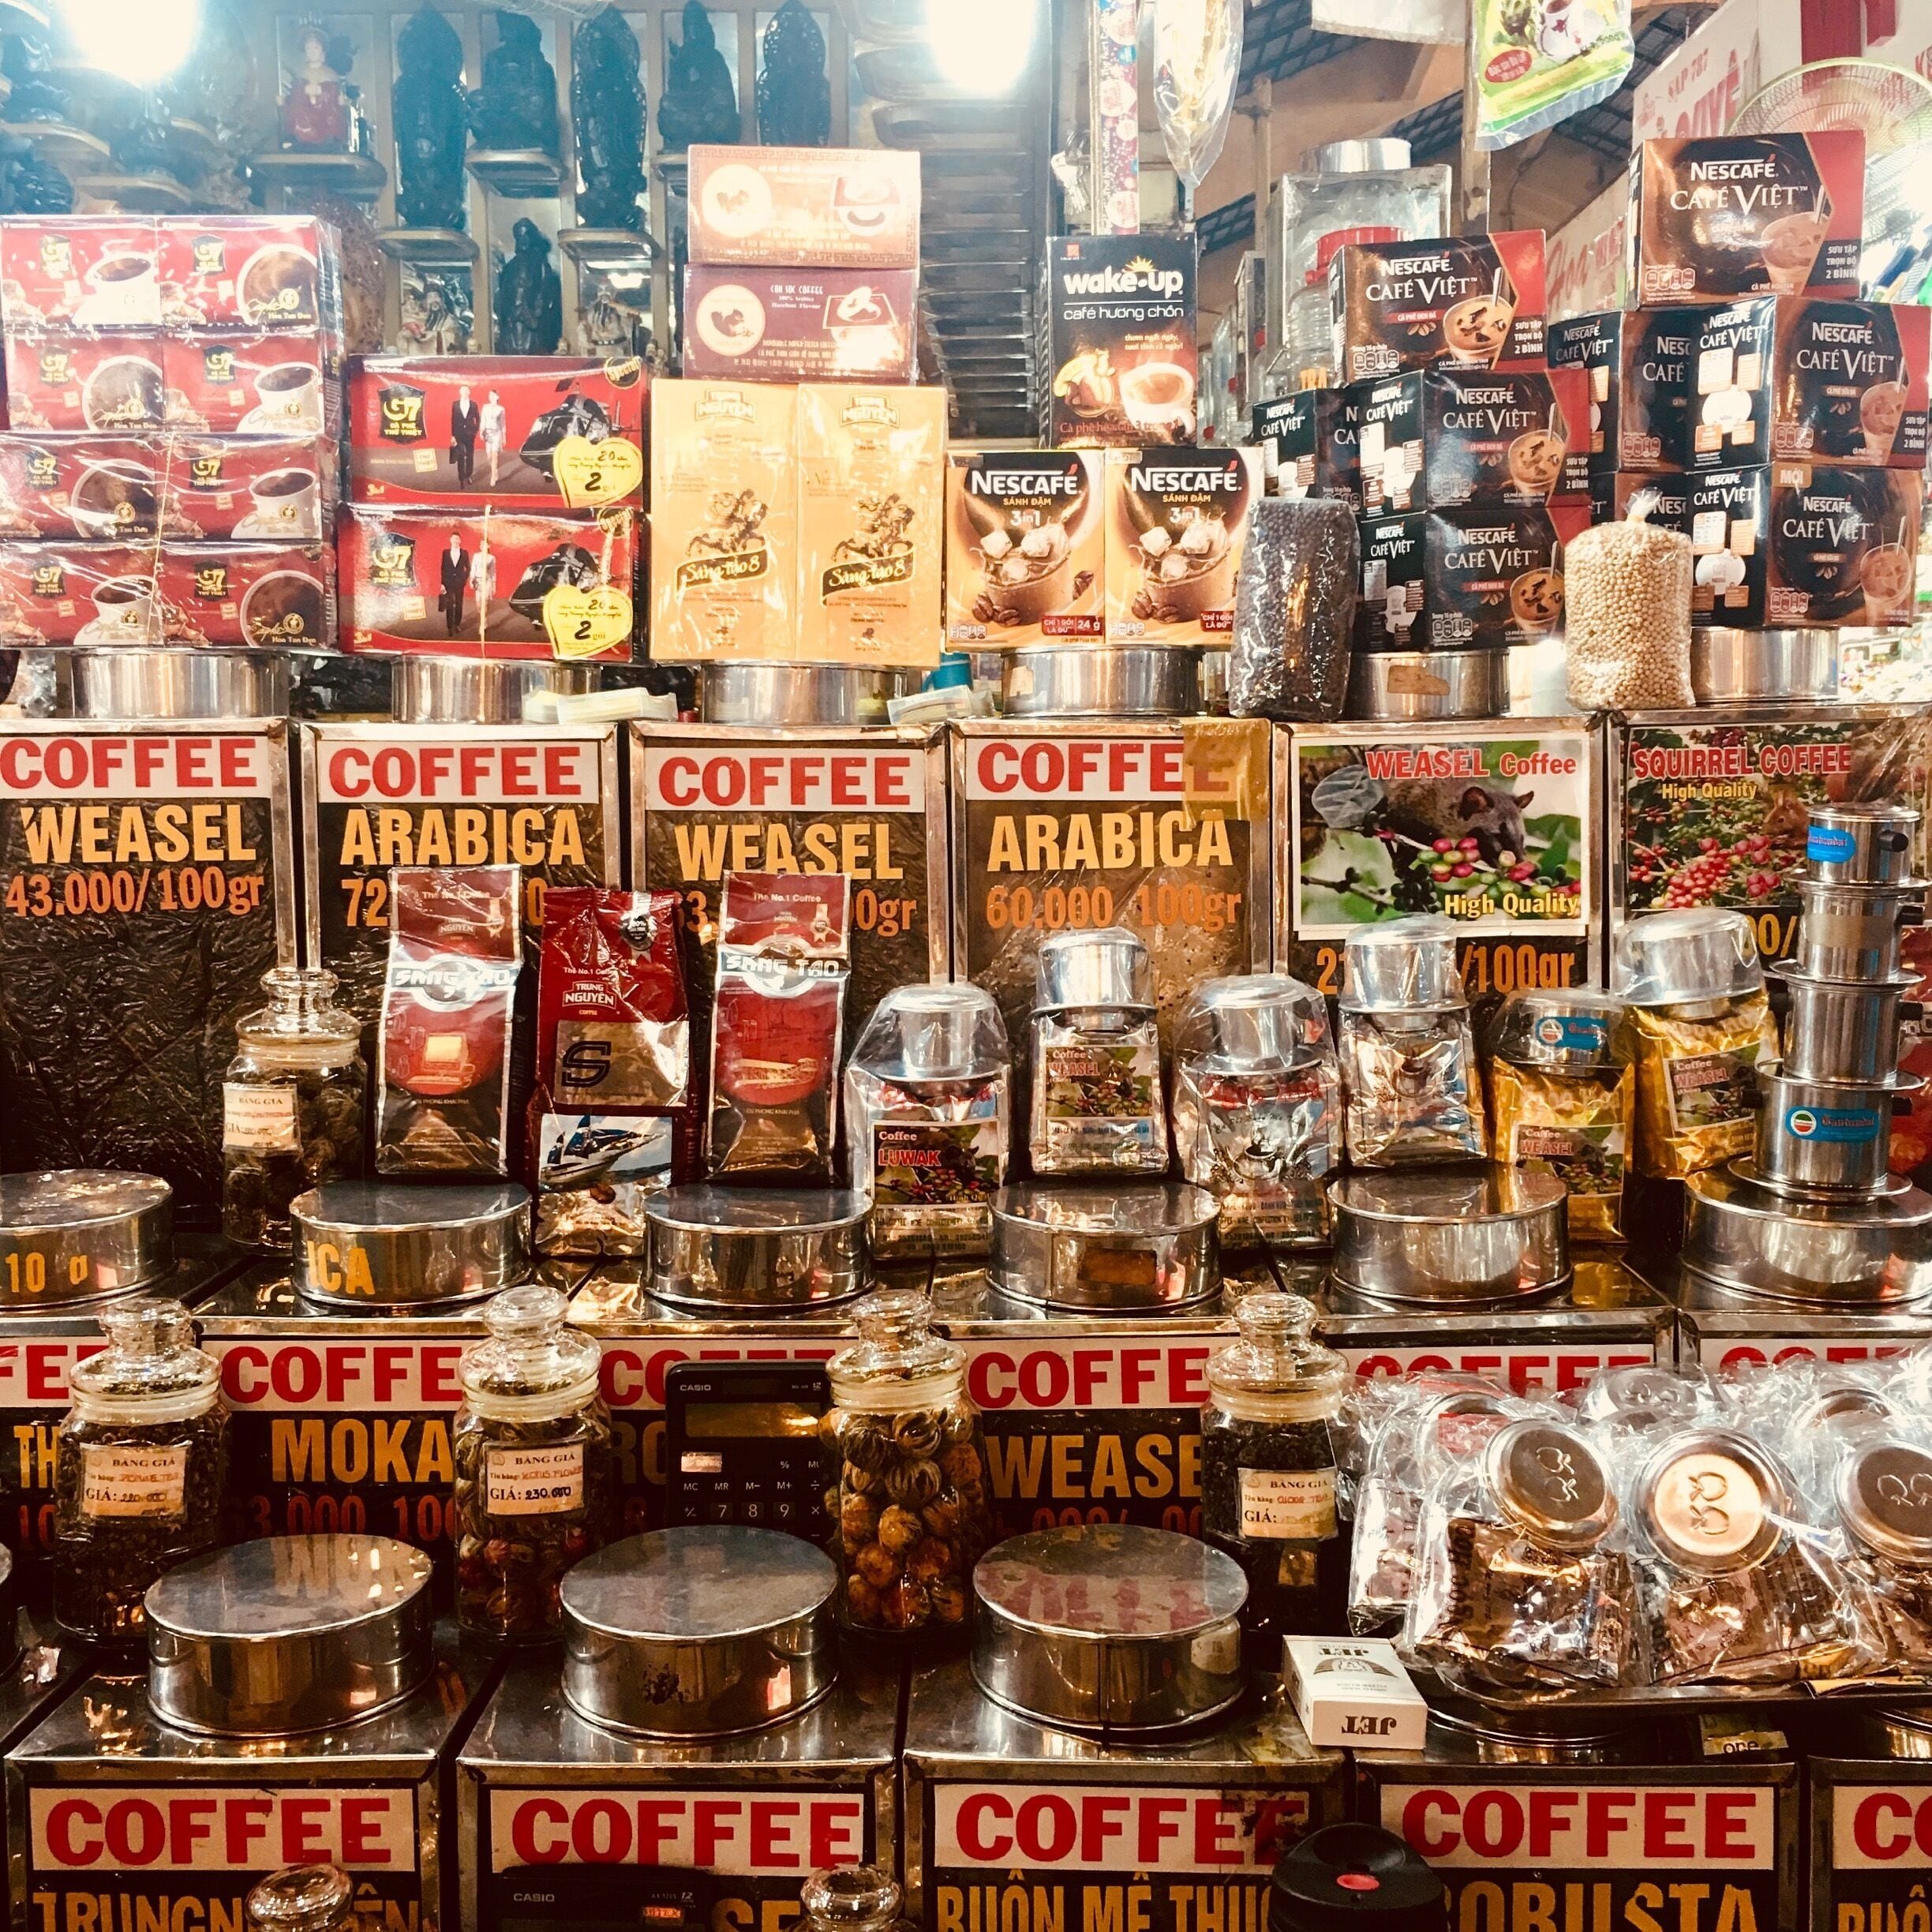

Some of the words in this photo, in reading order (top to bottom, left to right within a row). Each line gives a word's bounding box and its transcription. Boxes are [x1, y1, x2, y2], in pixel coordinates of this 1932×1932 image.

[1381, 251, 1453, 276] NESCAFÉ
[1366, 278, 1414, 302] CAFÉ
[1064, 306, 1096, 320] café
[1563, 320, 1601, 343] NESCAFÉ
[1700, 334, 1728, 349] CAFÉ
[1812, 320, 1874, 345] NESCAFÉ
[1515, 346, 1521, 354] 2
[1642, 362, 1685, 383] CAFÉ
[1796, 349, 1840, 371] CAFÉ
[1840, 349, 1887, 380] VIỆT
[1456, 384, 1516, 405] NESCAFÉ
[384, 397, 421, 421] G7
[1443, 409, 1485, 429] CAFÉ
[1485, 408, 1530, 436] VIỆT
[585, 472, 602, 492] 2
[972, 464, 1080, 495] NESCAFÉ
[1131, 460, 1240, 492] NESCAFÉ
[1566, 481, 1571, 489] 2
[1003, 496, 1029, 506] SÁNH
[1031, 496, 1052, 508] ĐẬM
[1162, 494, 1188, 503] SÁNH
[1189, 493, 1211, 505] ĐẬM
[1694, 491, 1720, 506] CAFÉ
[1458, 522, 1517, 545] NESCAFÉ
[1783, 518, 1825, 538] CAFÉ
[373, 545, 414, 569] G7
[749, 555, 761, 573] 8
[894, 558, 906, 575] 8
[1444, 550, 1486, 570] CAFÉ
[1486, 548, 1532, 575] VIỆT
[574, 620, 592, 640] 2
[1077, 620, 1091, 630] 24
[0, 738, 257, 789] COFFEE
[328, 746, 582, 798] COFFEE
[1365, 749, 1490, 779] WEASEL
[1500, 752, 1577, 777] Coffee
[1633, 745, 1754, 780] SQUIRREL
[1760, 743, 1851, 776] COFFEE
[658, 756, 911, 807] COFFEE
[1661, 782, 1696, 801] High
[1702, 781, 1758, 801] Quality
[20, 803, 257, 864] WEASEL
[339, 808, 586, 866] ARABICA
[987, 810, 1234, 871] ARABICA
[674, 822, 904, 882] WEASEL
[754, 893, 769, 902] The
[771, 893, 790, 902] No.1
[792, 894, 822, 903] Coffee
[1444, 893, 1495, 918] High
[1503, 892, 1580, 917] Quality
[575, 983, 605, 992] TRUNG
[561, 1041, 612, 1088] S
[1052, 1050, 1087, 1059] Coffee
[1676, 1059, 1713, 1070] Coffee
[1673, 1067, 1731, 1088] WEASEL
[878, 1131, 918, 1142] Coffee
[1524, 1128, 1561, 1139] Coffee
[878, 1148, 942, 1167] LUWAK
[1520, 1139, 1574, 1156] WEASEL
[221, 1346, 463, 1403] COFFE
[968, 1347, 1210, 1409] COFFE
[271, 1418, 454, 1484] MOKA
[985, 1433, 1202, 1499] WEASE
[490, 1485, 522, 1500] GIÁ:
[683, 1482, 699, 1491] MC
[714, 1482, 729, 1491] MR
[777, 1481, 793, 1490] M+
[717, 1504, 727, 1518] 7
[748, 1503, 758, 1518] 8
[780, 1503, 790, 1518] 9
[1245, 1508, 1278, 1523] GIÁ:
[1341, 1715, 1397, 1736] JET
[46, 1798, 391, 1866] COFFEE
[511, 1798, 860, 1868] COFFEE
[1402, 1789, 1757, 1859] COFFEE
[514, 1893, 556, 1902] CASIO
[1444, 1880, 1758, 1932] OBUSTA
